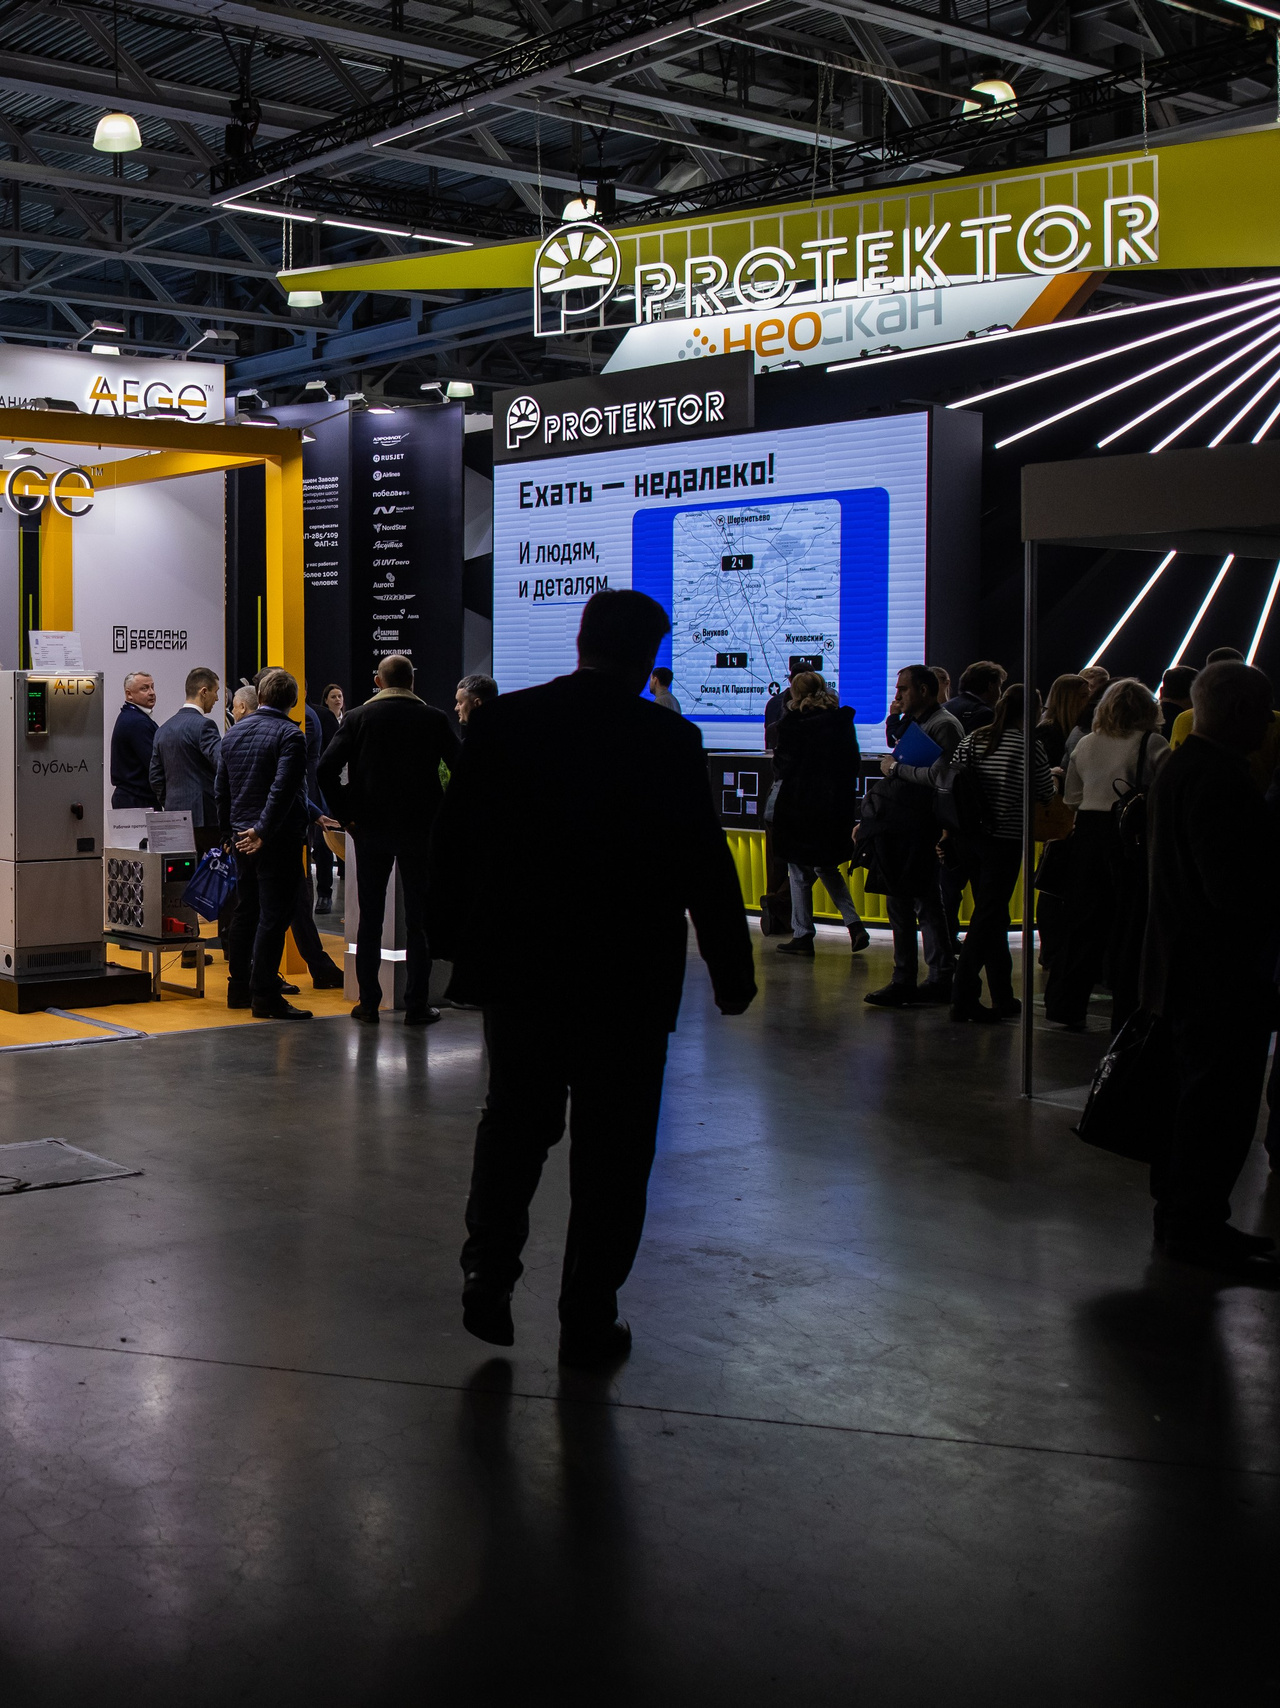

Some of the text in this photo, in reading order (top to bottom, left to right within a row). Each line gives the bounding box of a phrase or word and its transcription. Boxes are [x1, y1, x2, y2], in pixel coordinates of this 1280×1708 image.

[634, 194, 1160, 324] PROTEKTOR
[544, 391, 725, 444] PROTEKTOR
[519, 481, 592, 509] Ехать
[634, 453, 774, 499] недалеко!
[727, 514, 770, 525] Шереметьево
[520, 541, 599, 565] И людям,
[519, 575, 608, 600] и деталям
[130, 629, 187, 640] СДЕЛАНО
[702, 628, 728, 638] Внуково
[785, 633, 824, 645] Жуковский
[53, 678, 95, 696] АЕГЭ
[701, 684, 764, 696] Склад ГК Протектор
[32, 759, 88, 776] дубль-А
